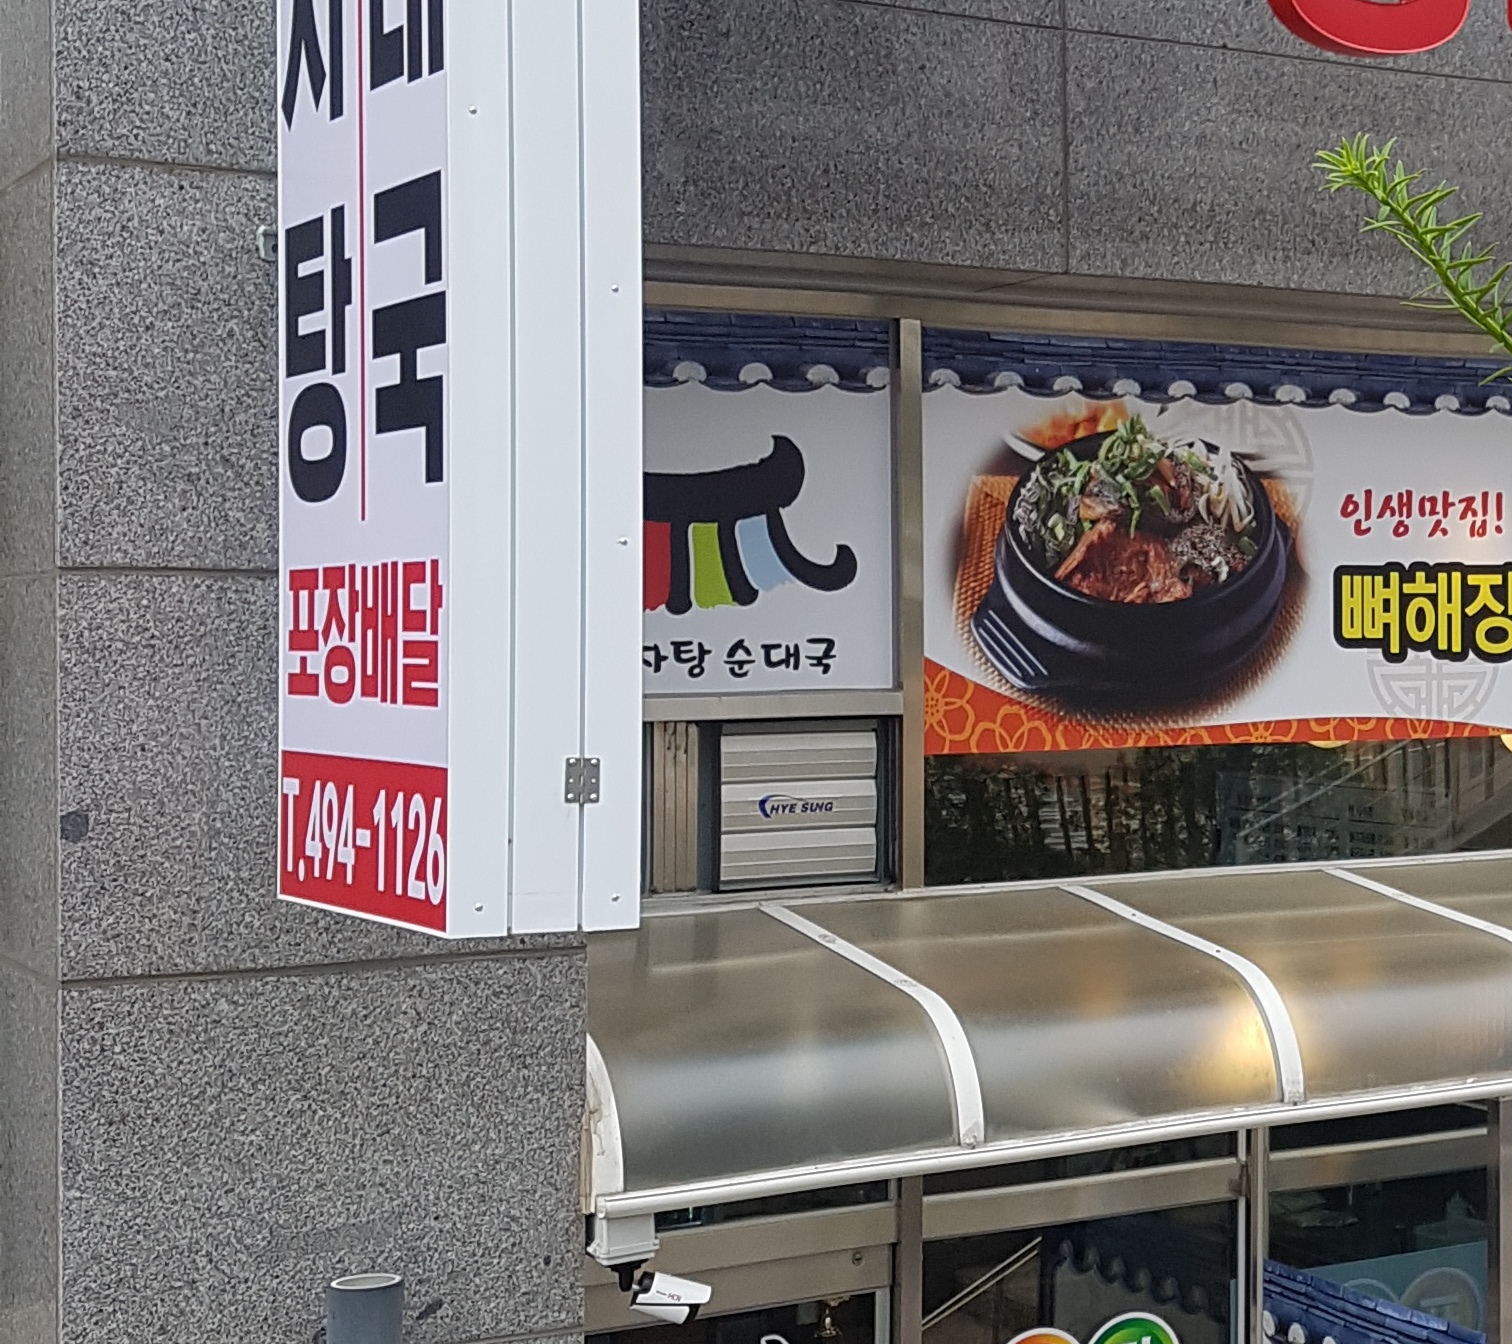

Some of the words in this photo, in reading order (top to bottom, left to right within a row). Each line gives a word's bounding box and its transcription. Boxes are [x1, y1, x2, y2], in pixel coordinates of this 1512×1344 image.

[1340, 488, 1504, 538] 인생맛집!
[287, 557, 444, 709] 포장배달
[723, 637, 837, 679] 순대국
[770, 802, 798, 815] HYE
[801, 801, 834, 814] SUNG
[283, 776, 446, 906] T.494-1126
